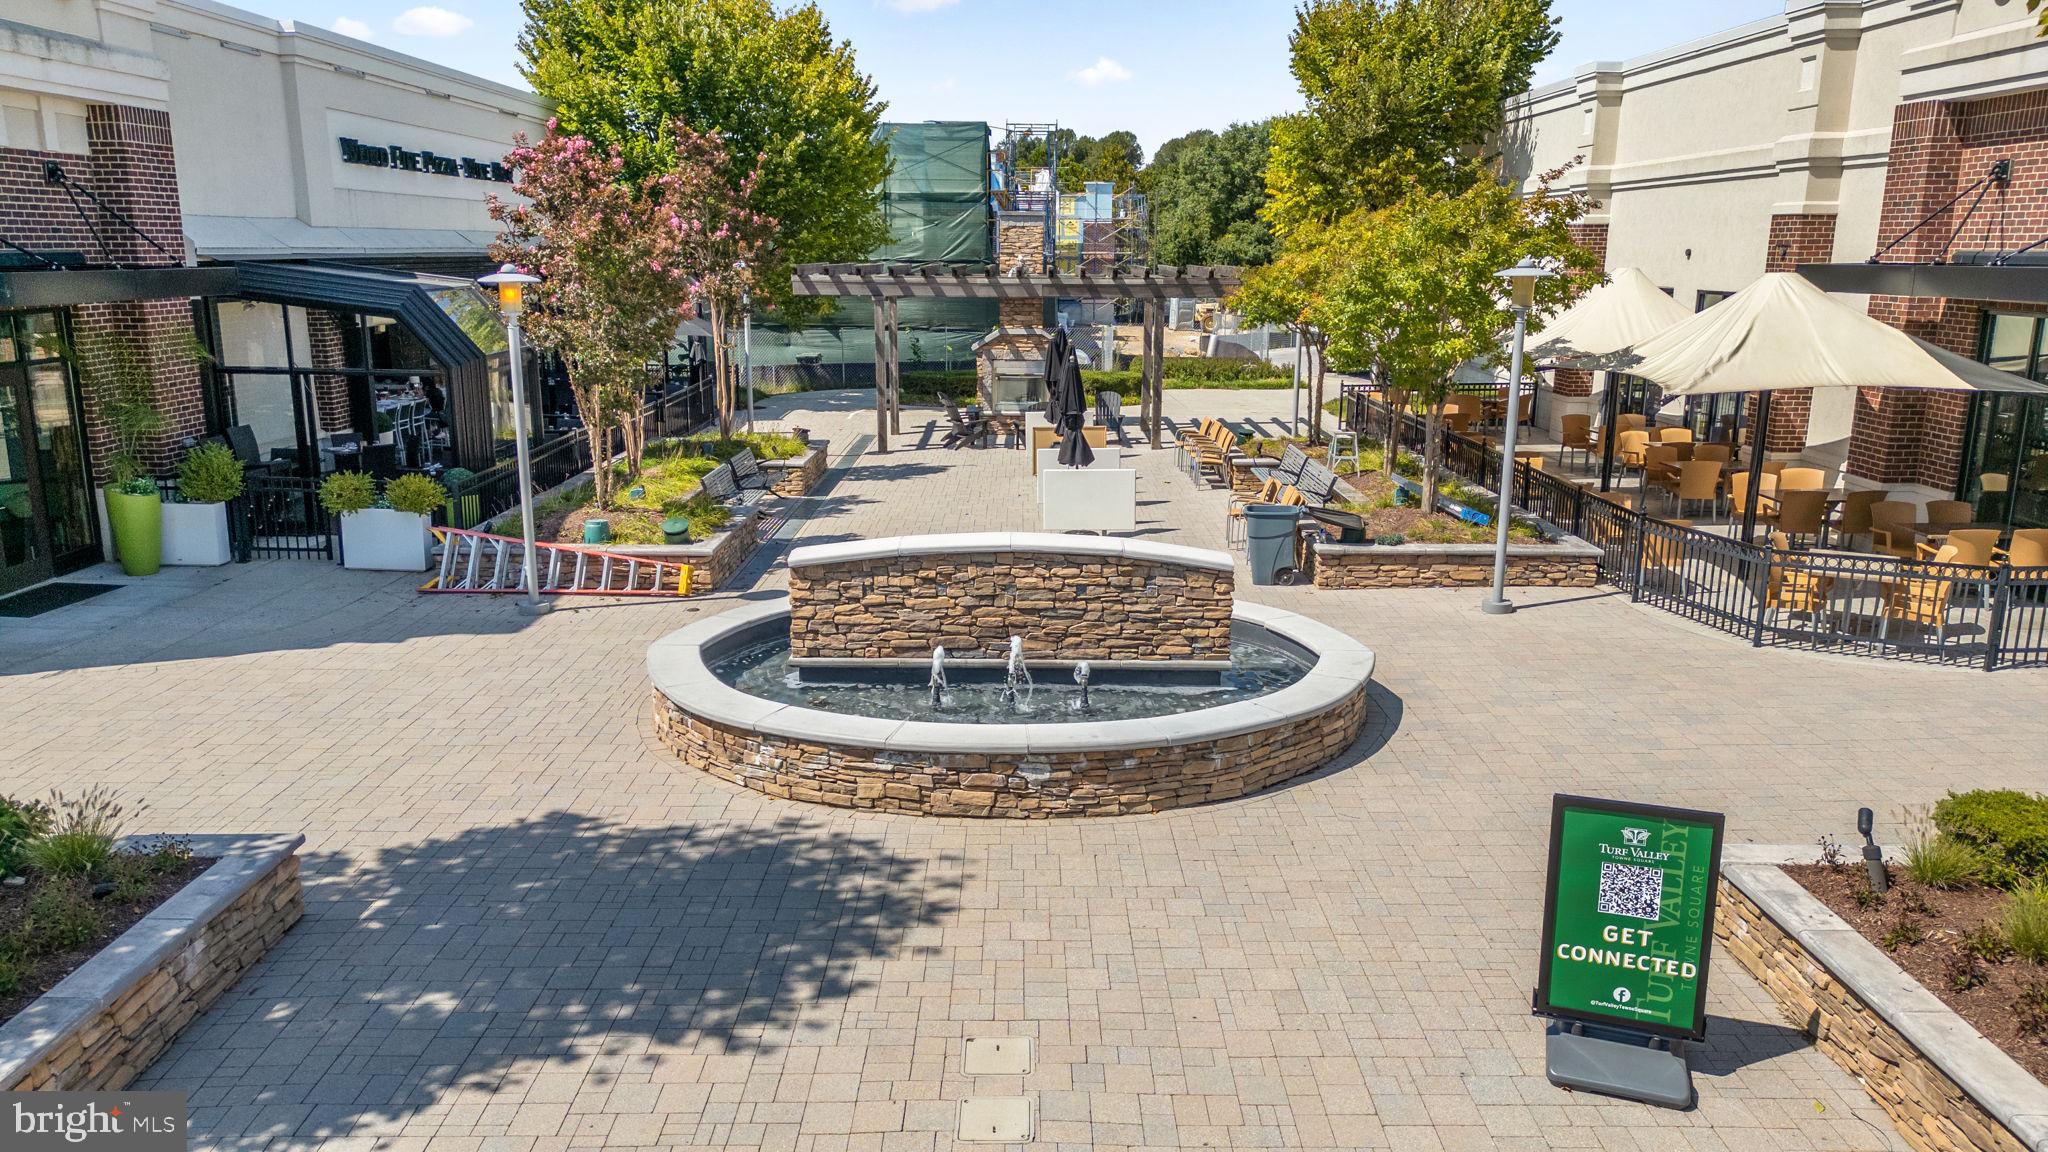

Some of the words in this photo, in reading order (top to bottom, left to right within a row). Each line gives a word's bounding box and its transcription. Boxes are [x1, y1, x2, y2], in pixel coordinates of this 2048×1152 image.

[1599, 843, 1629, 856] TURF
[1630, 847, 1670, 861] VALLEY
[1644, 819, 1689, 931] VALLEY
[1687, 865, 1705, 928] SQUARE
[1602, 925, 1653, 947] GET
[1557, 943, 1697, 979] CONNECTED
[1681, 936, 1698, 990] TNE
